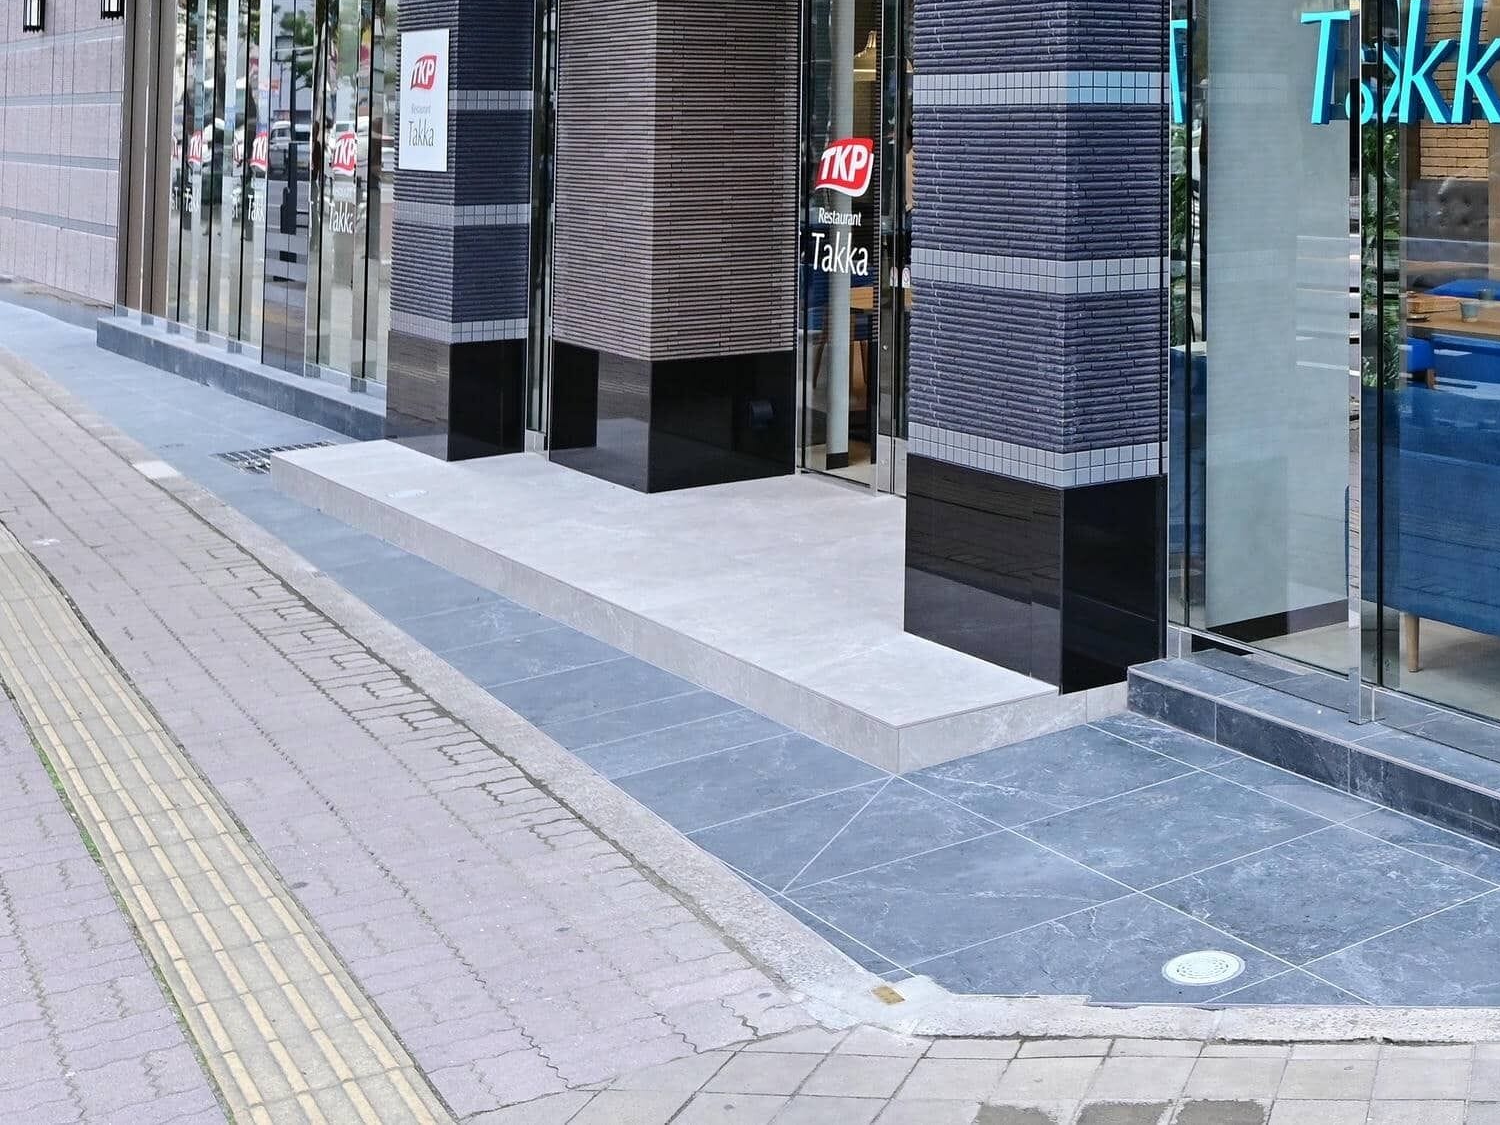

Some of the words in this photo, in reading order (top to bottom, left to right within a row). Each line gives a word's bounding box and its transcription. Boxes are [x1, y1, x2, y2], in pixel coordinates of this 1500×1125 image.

[411, 58, 436, 85] TKP
[408, 120, 435, 146] Takka
[820, 143, 869, 182] TKP
[818, 207, 862, 226] Restaurant
[811, 231, 869, 276] Takka
